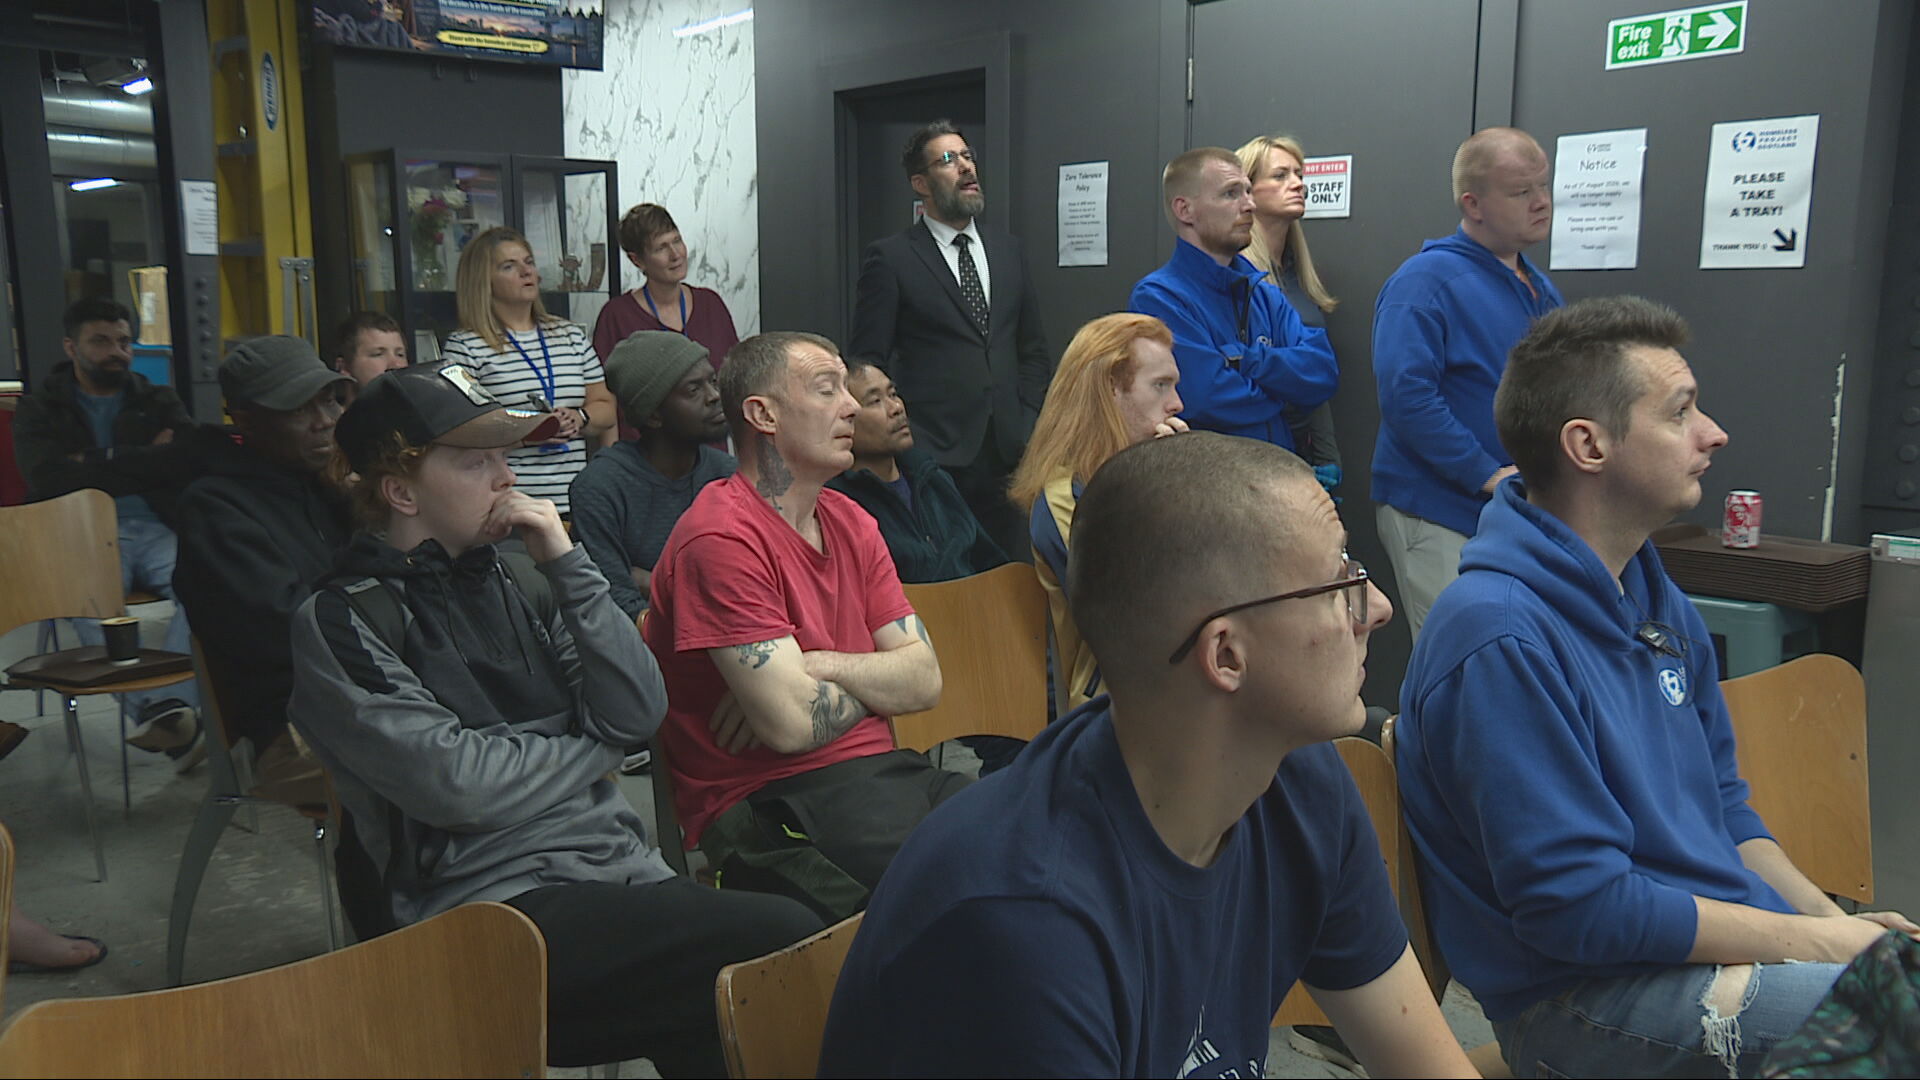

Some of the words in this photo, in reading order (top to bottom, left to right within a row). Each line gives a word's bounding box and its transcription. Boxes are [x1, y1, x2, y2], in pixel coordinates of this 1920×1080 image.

[1618, 25, 1652, 43] Fire
[1617, 40, 1650, 60] exit
[1305, 165, 1319, 173] NOT
[1321, 163, 1344, 172] ENTER
[1579, 159, 1617, 171] Notice
[1733, 172, 1785, 185] PLEASE
[1310, 181, 1344, 193] STAFF
[1311, 193, 1341, 204] ONLY
[1739, 189, 1776, 201] TAKE
[1729, 207, 1739, 217] A
[1743, 206, 1784, 217] TRAY!
[1712, 243, 1740, 251] THANK
[1743, 243, 1759, 251] YOU
